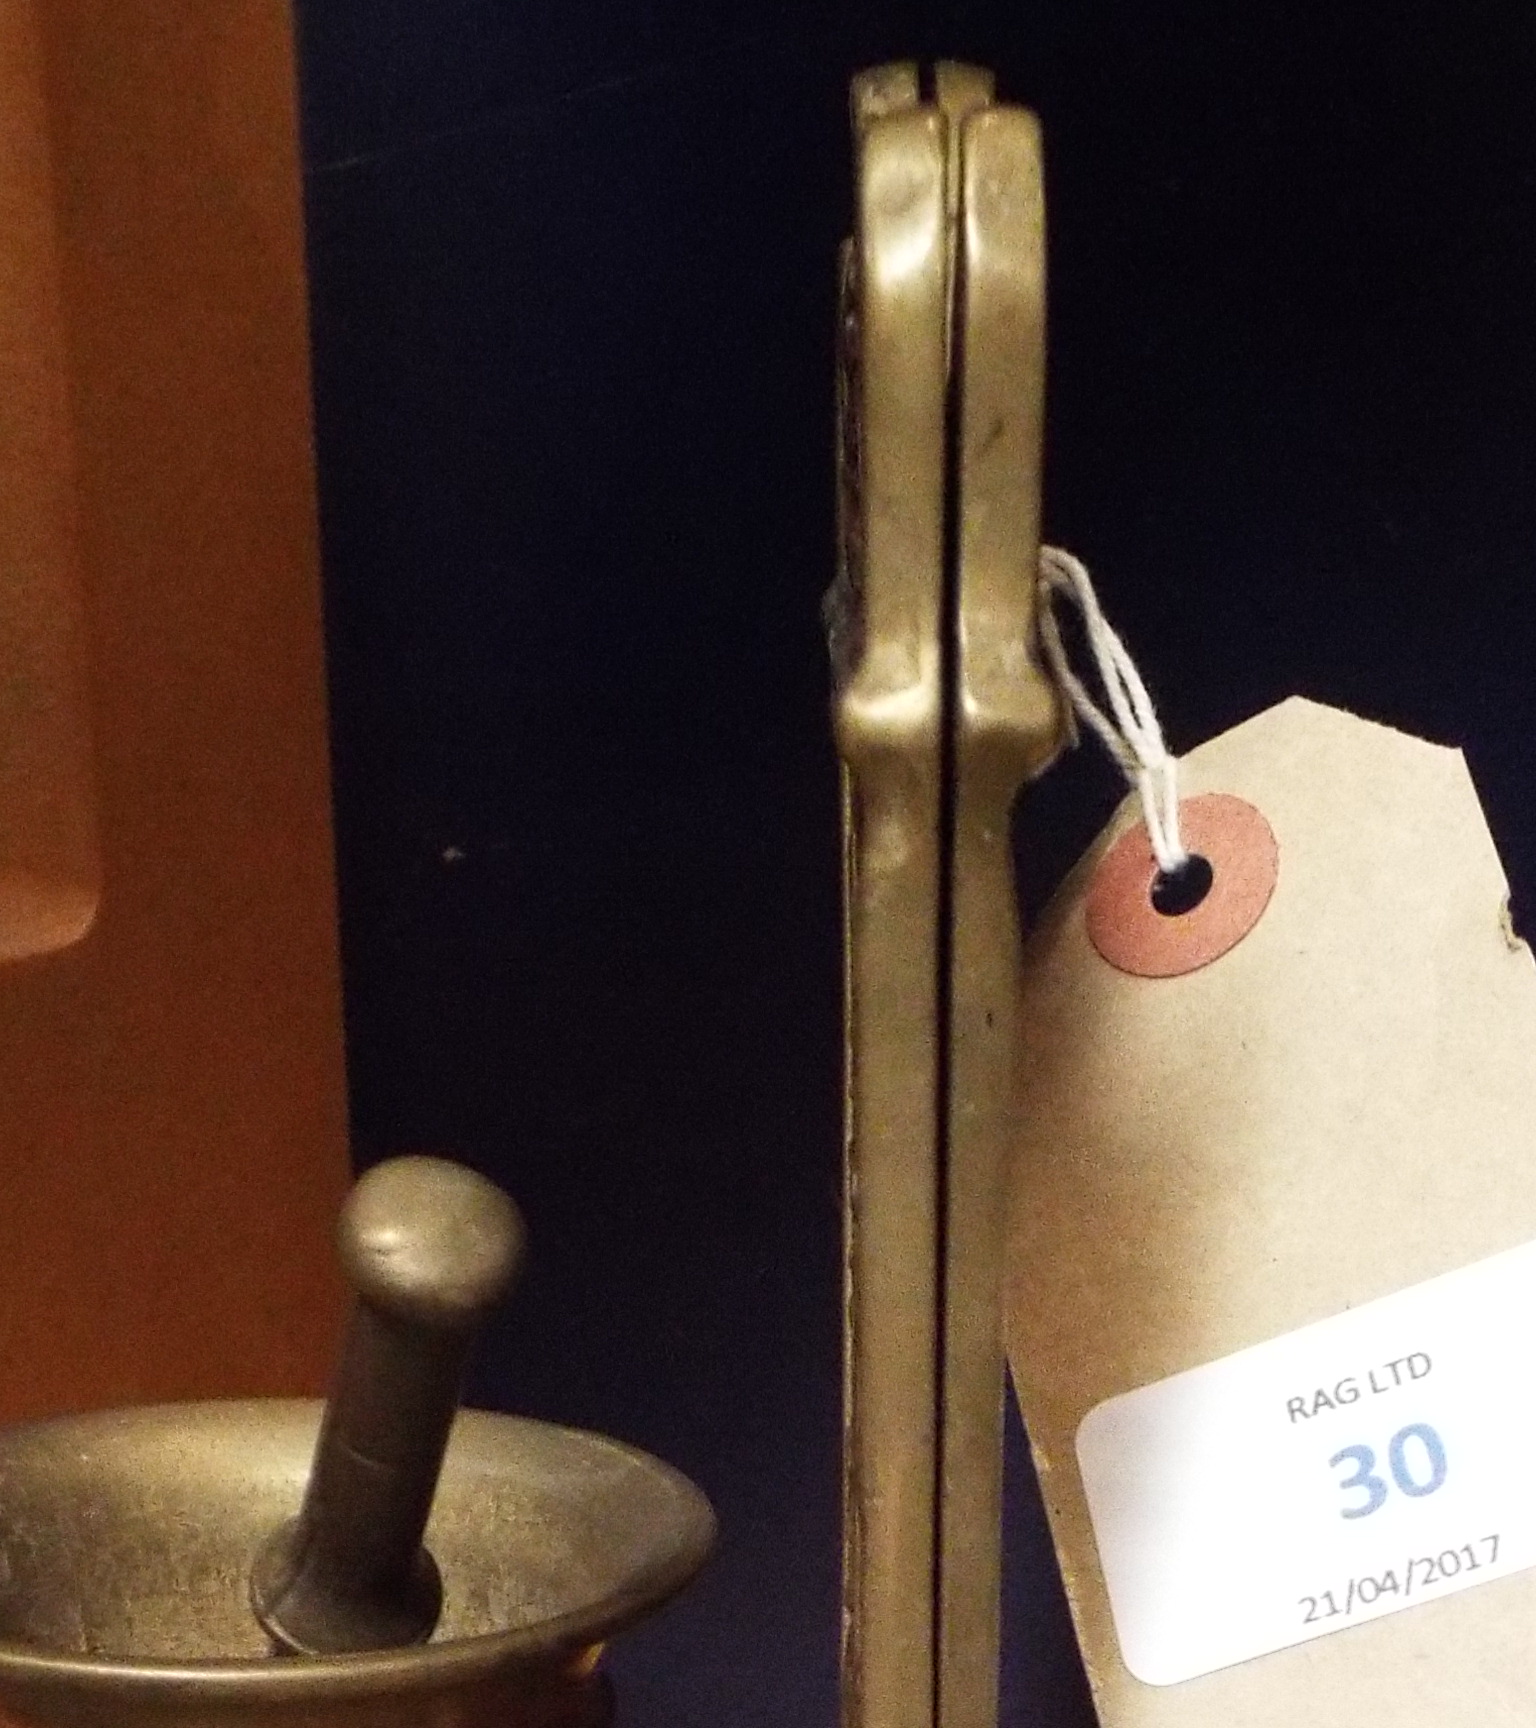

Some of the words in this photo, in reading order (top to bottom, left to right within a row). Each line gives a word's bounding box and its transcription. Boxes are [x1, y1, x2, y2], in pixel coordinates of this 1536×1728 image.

[1286, 1377, 1361, 1423] RAG
[1368, 1352, 1432, 1394] LTD
[1328, 1422, 1447, 1519] 30
[1299, 1535, 1501, 1624] 21/04/2017
